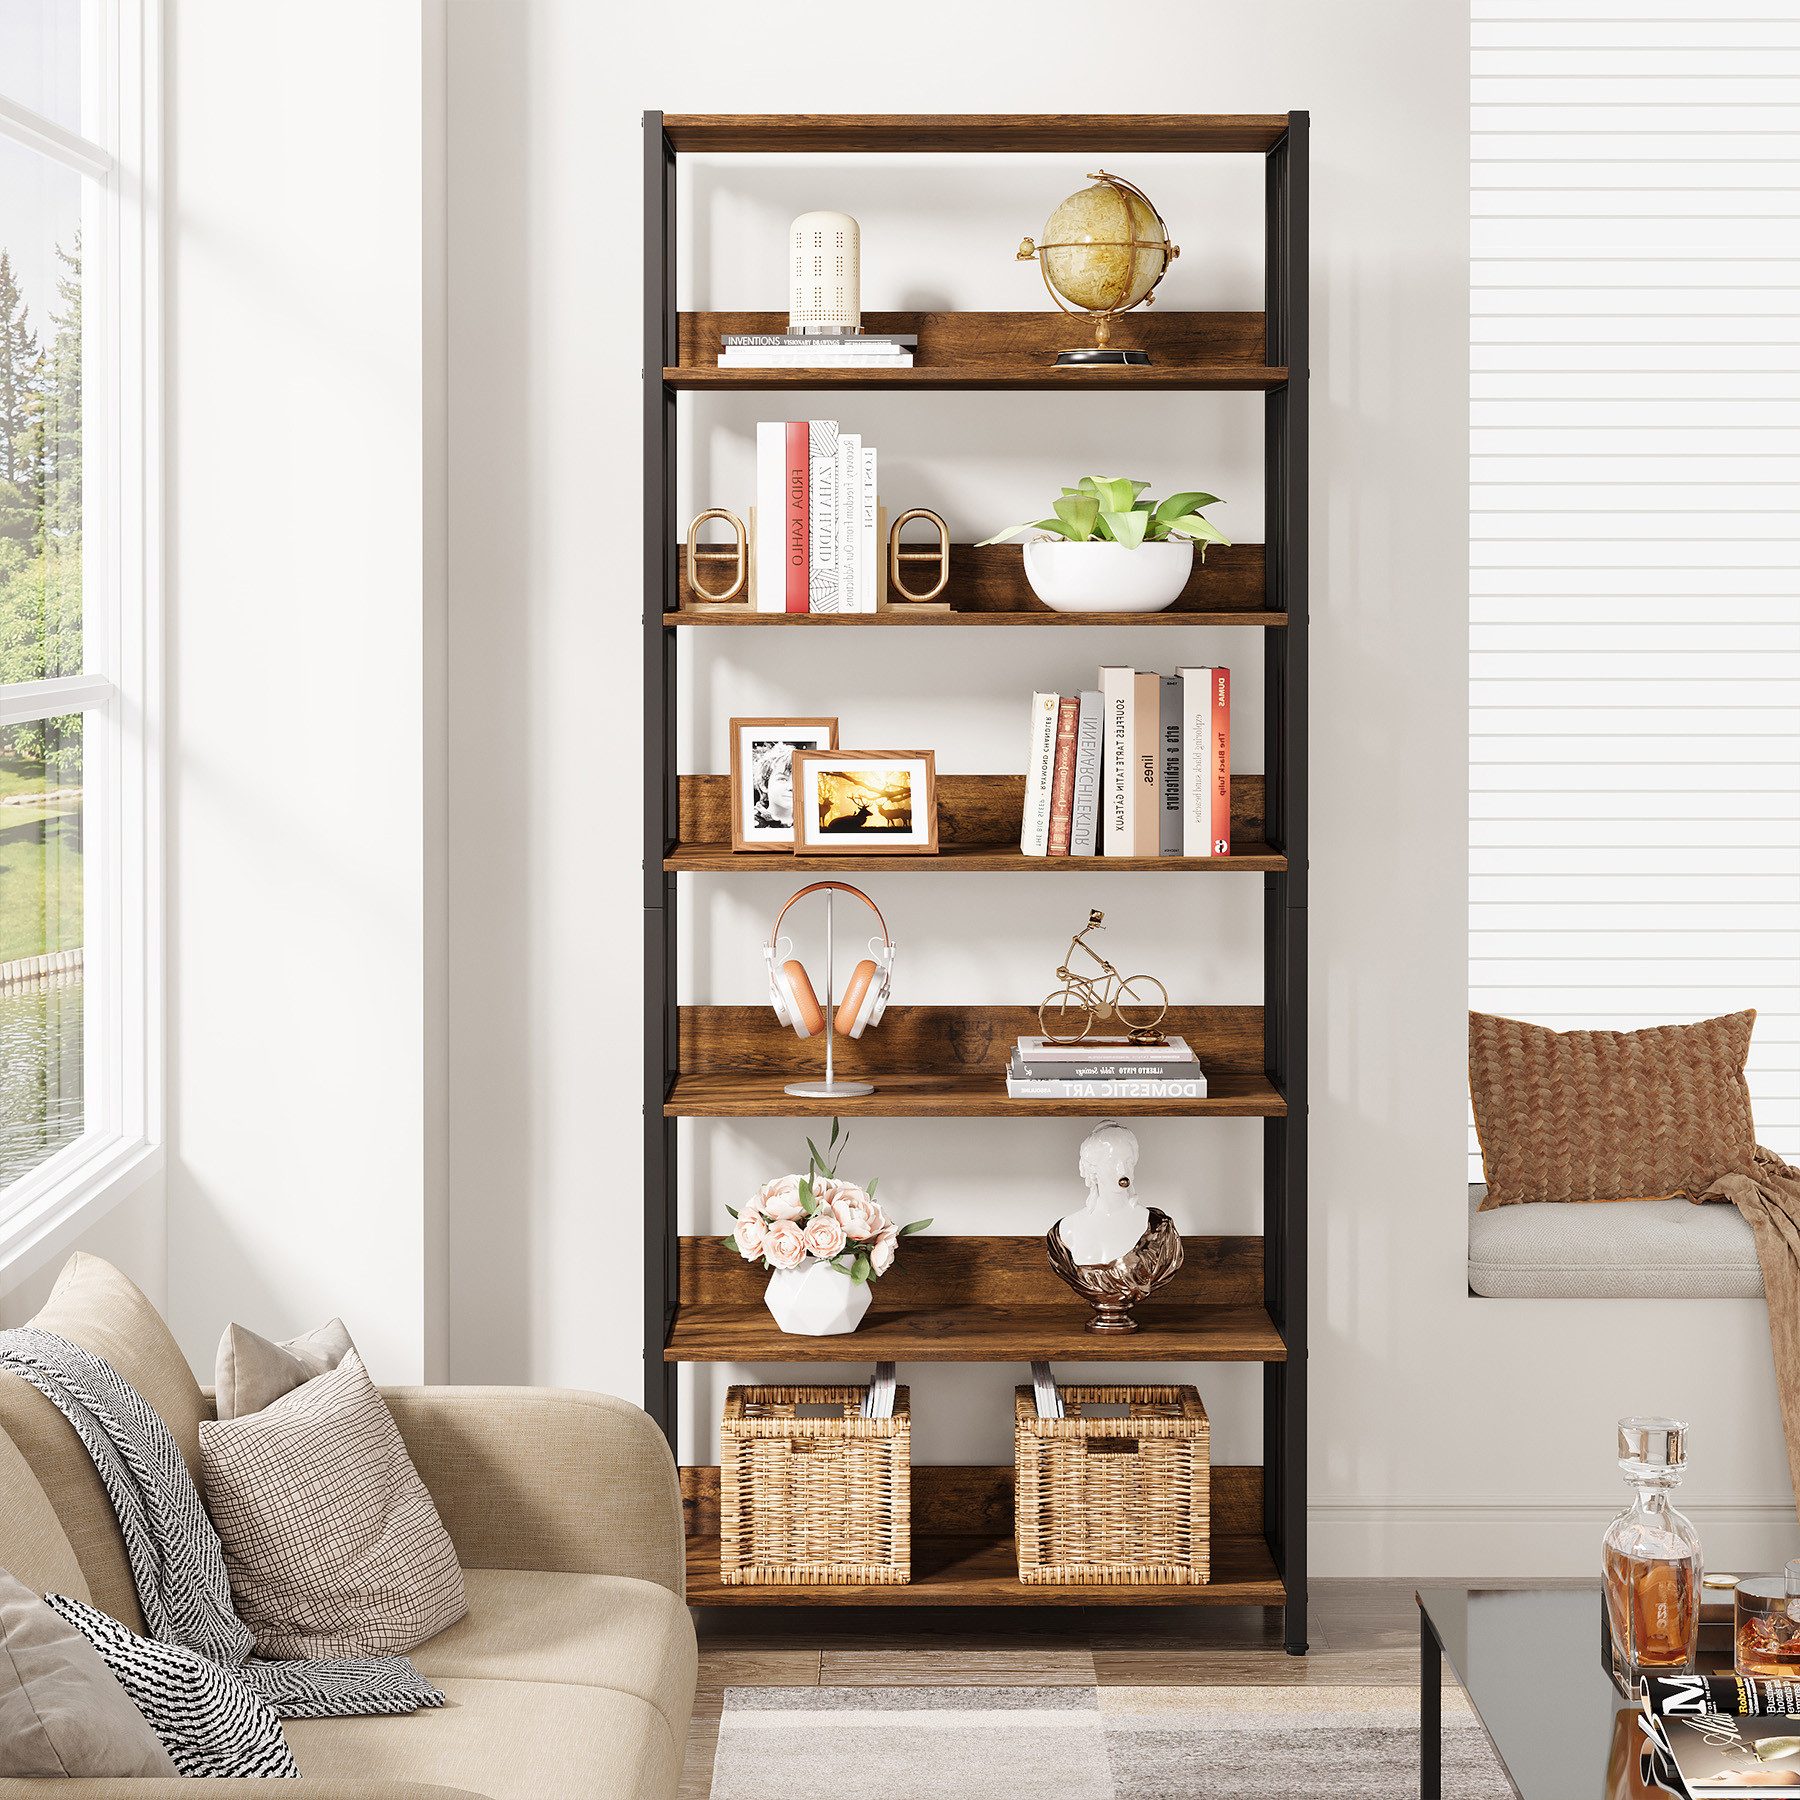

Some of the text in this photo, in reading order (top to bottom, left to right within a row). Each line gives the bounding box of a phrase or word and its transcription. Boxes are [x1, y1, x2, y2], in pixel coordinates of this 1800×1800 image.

[728, 336, 780, 346] INVENTIONS
[1736, 1688, 1748, 1714] Robot
[1763, 1680, 1776, 1713] Business
[1774, 1688, 1786, 1713] hotels
[1784, 1686, 1795, 1714] events
